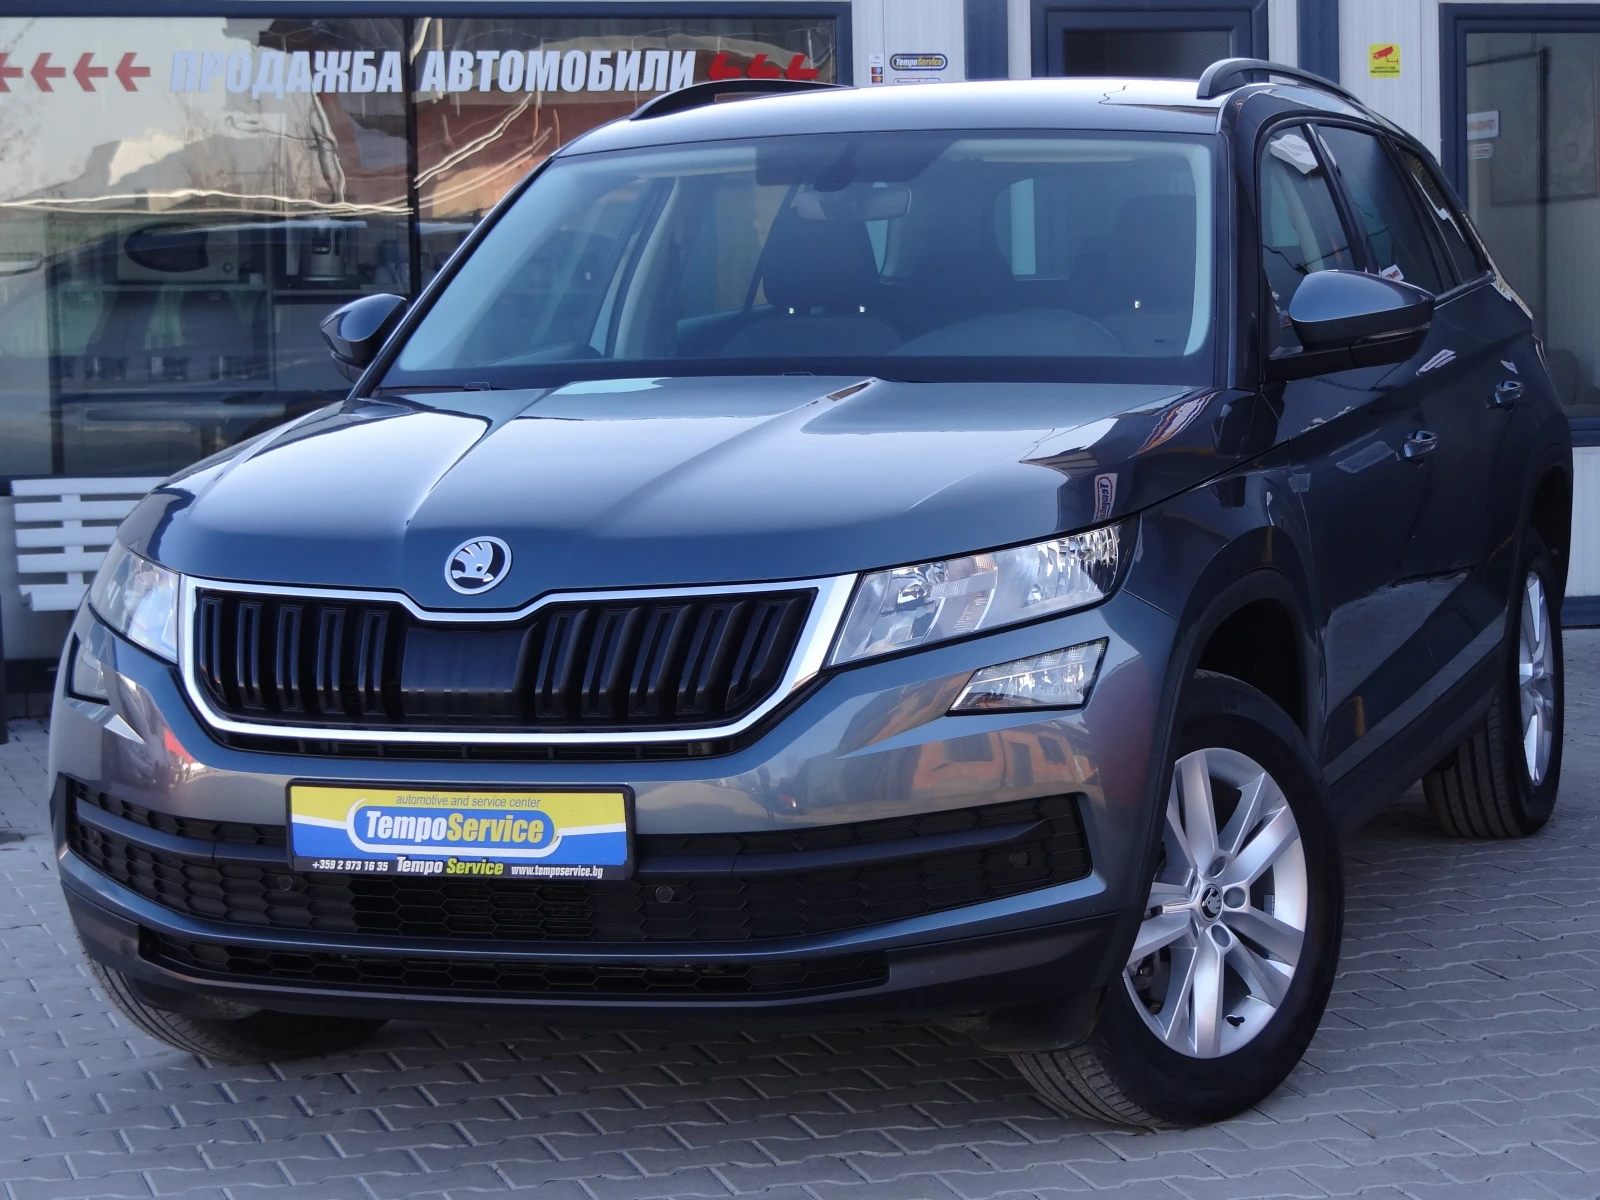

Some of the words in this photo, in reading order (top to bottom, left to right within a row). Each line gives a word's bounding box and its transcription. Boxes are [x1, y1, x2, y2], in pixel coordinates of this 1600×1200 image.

[895, 57, 943, 69] TempoService
[170, 50, 403, 100] ПРОДАЖБА
[419, 50, 697, 92] АВТОМОБИЛИ
[396, 794, 449, 806] automotive
[450, 795, 470, 807] and
[471, 795, 507, 807] service
[509, 797, 541, 808] center
[366, 809, 544, 844] TempoService
[312, 859, 336, 870] +359
[337, 860, 344, 870] 2
[345, 860, 362, 871] 973
[364, 861, 375, 871] 16
[376, 861, 389, 872] 35
[396, 856, 444, 876] Tempo
[446, 857, 504, 876] Service
[511, 864, 604, 879] www.temposervice.bg
